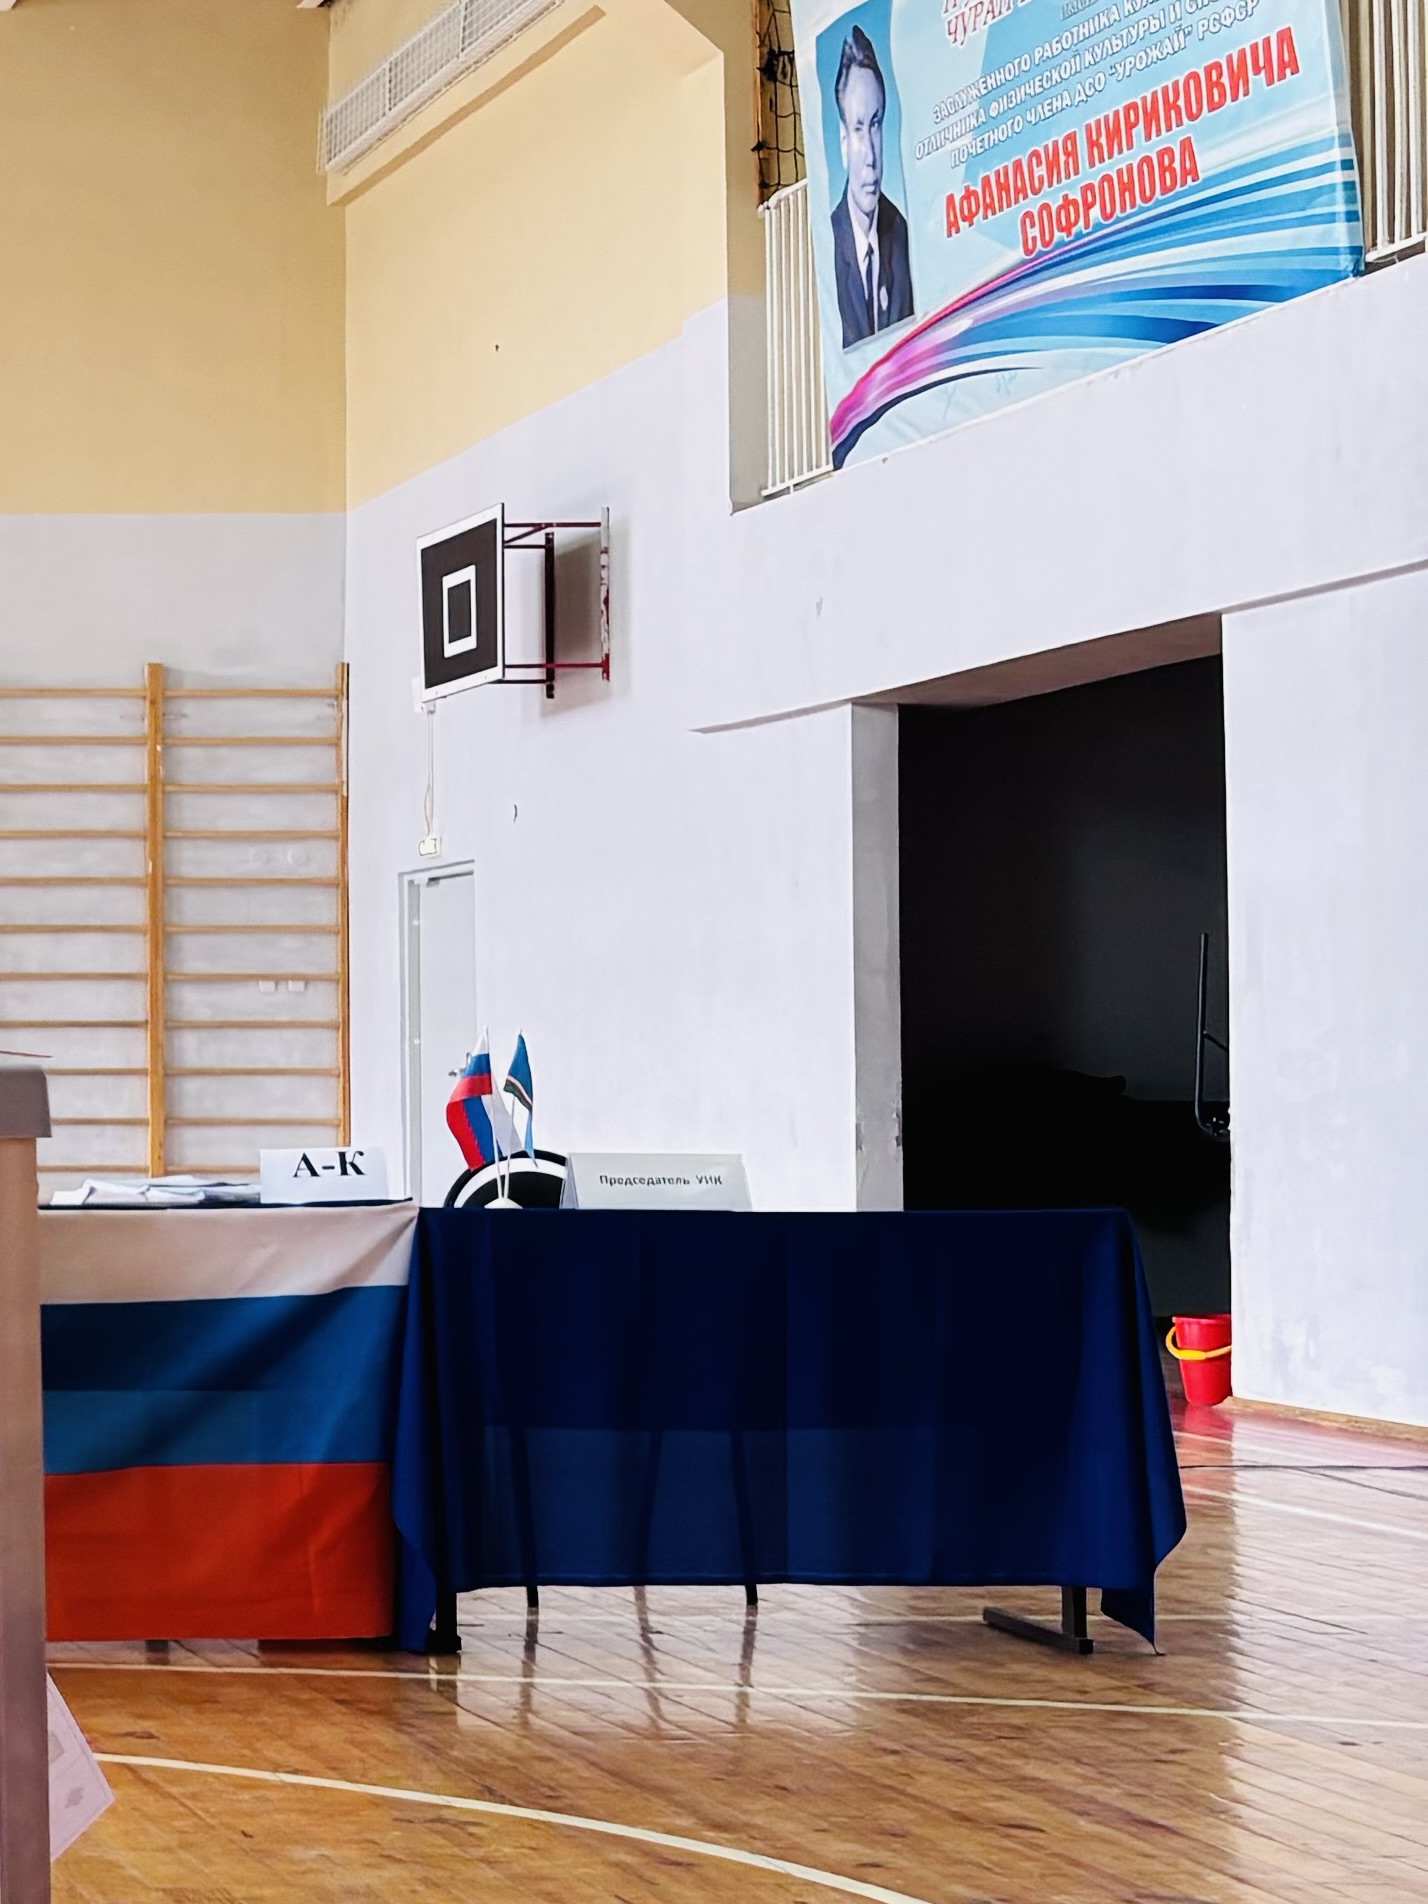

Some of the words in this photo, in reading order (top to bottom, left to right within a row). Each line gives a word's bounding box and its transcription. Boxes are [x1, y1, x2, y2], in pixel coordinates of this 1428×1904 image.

[915, 111, 986, 160] ОТЛИЧНИКА
[989, 50, 1081, 118] ФИЗИЧЕСКОЙ
[1085, 9, 1165, 68] КУЛЬТУРЫ
[1169, 0, 1181, 23] И
[933, 53, 1031, 124] ЗАСЛУЖЕННОГО
[1034, 4, 1120, 65] РАБОТНИКА
[951, 115, 1023, 168] ПОЧЕТНОГО
[1026, 90, 1072, 125] ЧЛЕНА
[1074, 72, 1106, 106] ДСО
[945, 130, 1079, 238] АФАНАСИЯ
[1084, 26, 1299, 168] КИРИКОВИЧА
[1020, 136, 1200, 256] СОФРОНОВА
[293, 1151, 366, 1177] А-К
[599, 1175, 690, 1186] Председатель
